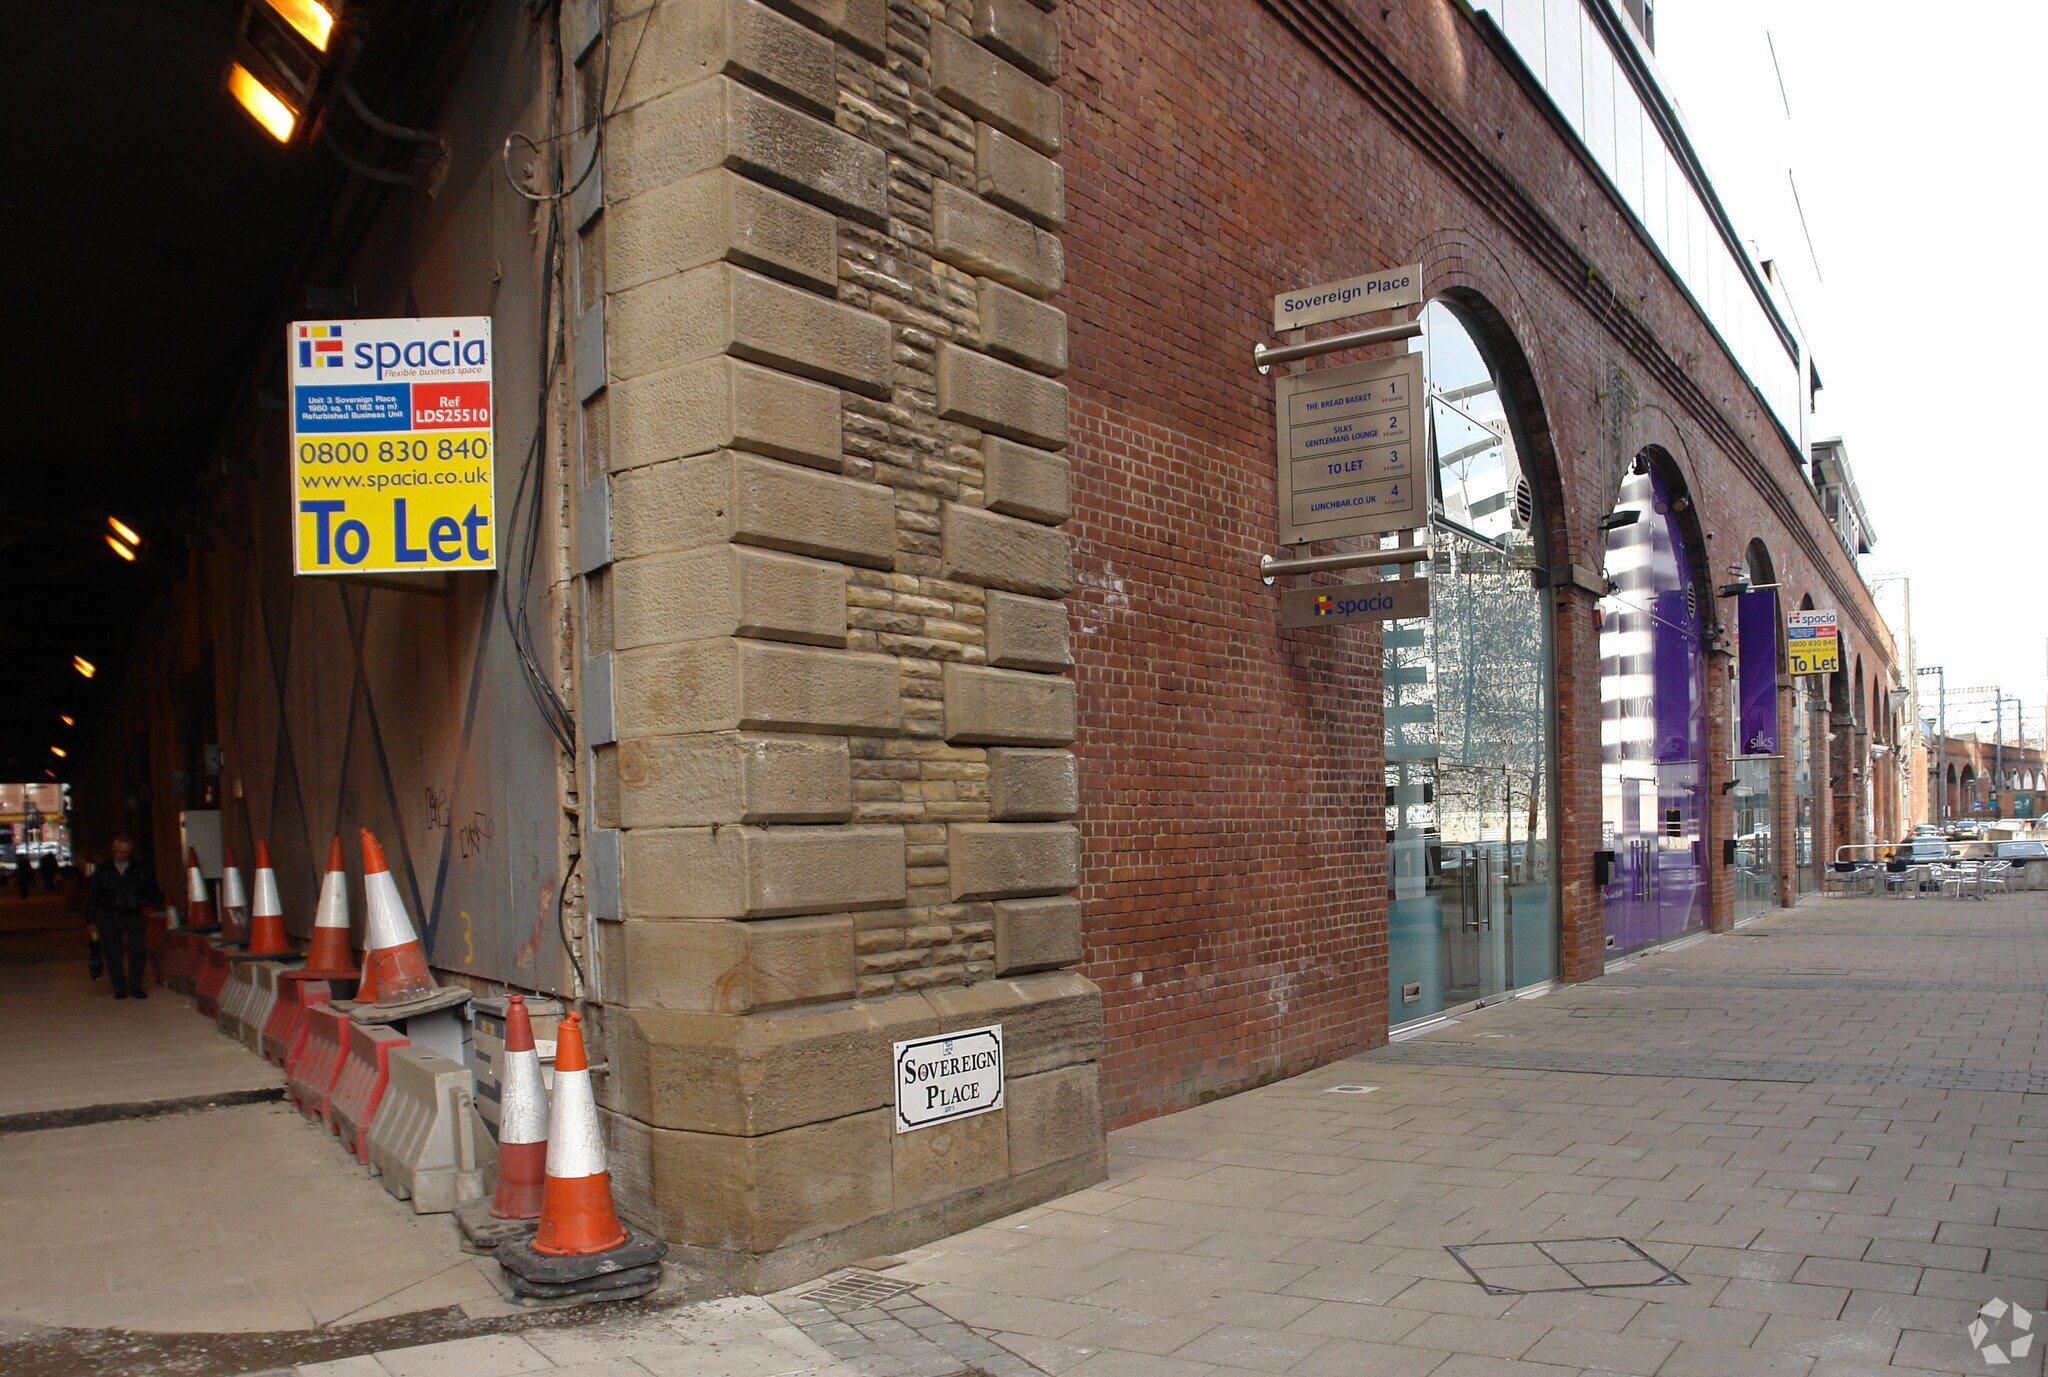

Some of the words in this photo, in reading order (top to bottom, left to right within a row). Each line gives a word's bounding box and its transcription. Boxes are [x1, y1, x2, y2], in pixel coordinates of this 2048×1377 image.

[1284, 288, 1361, 313] Sovereign
[1367, 276, 1410, 295] Place
[354, 330, 486, 381] spacia
[384, 369, 417, 377] Flexible
[419, 367, 455, 376] business
[457, 367, 482, 376] space
[1389, 382, 1395, 394] 1
[335, 396, 373, 404] Sovereign
[439, 396, 461, 408] Ref
[1306, 403, 1319, 411] THE
[1320, 399, 1344, 409] BREAD
[1345, 393, 1372, 404] BASKET
[302, 411, 349, 420] Refurbished
[351, 411, 386, 419] Business
[416, 408, 488, 423] LDS25510
[1389, 416, 1397, 429] 2
[1333, 424, 1353, 434] SILKS
[1305, 434, 1350, 448] GENTLEMANS
[1352, 429, 1379, 440] LOUNGE
[299, 442, 369, 464] 0800
[378, 440, 428, 463] 830
[437, 437, 488, 460] 840
[1390, 450, 1398, 463] 3
[1327, 463, 1342, 475] TO
[1345, 459, 1363, 472] LET
[301, 466, 489, 492] www.spacia.co.uk
[1391, 484, 1399, 497] 4
[1310, 495, 1377, 512] LUNCHBAR.CO.UK
[300, 499, 371, 565] To
[394, 497, 489, 563] Let
[1336, 592, 1394, 617] spacia
[1802, 612, 1836, 626] spacia
[1790, 640, 1807, 648] 0800
[1808, 639, 1822, 647] 830
[1790, 655, 1808, 672] To
[1812, 654, 1837, 671] Let
[1750, 730, 1774, 749] silks
[904, 1050, 997, 1085] SOVEREIGN
[926, 1082, 980, 1110] PLACE
